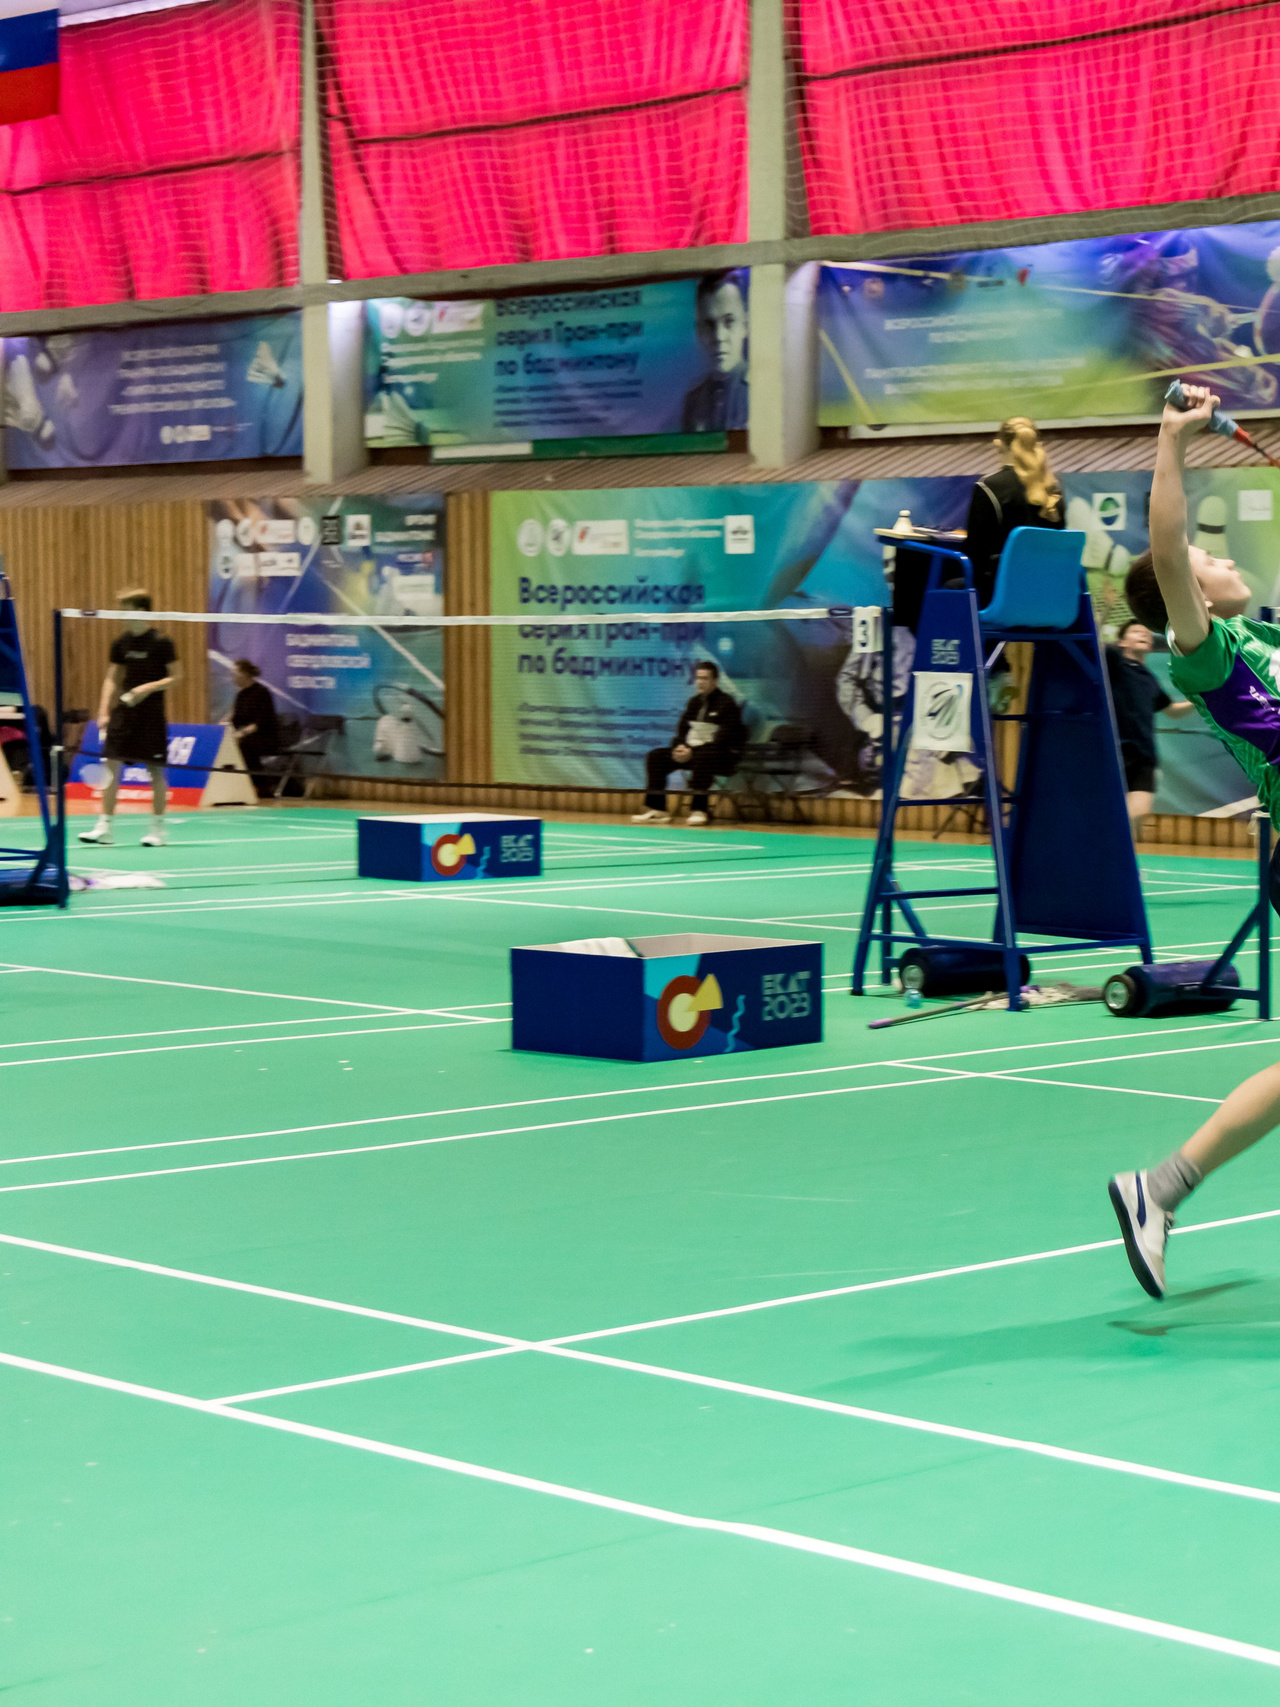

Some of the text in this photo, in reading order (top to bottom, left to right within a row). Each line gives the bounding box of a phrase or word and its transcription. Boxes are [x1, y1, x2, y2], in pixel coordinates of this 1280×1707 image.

[518, 576, 705, 612] Всероссийская
[518, 647, 698, 686] по бадминтону
